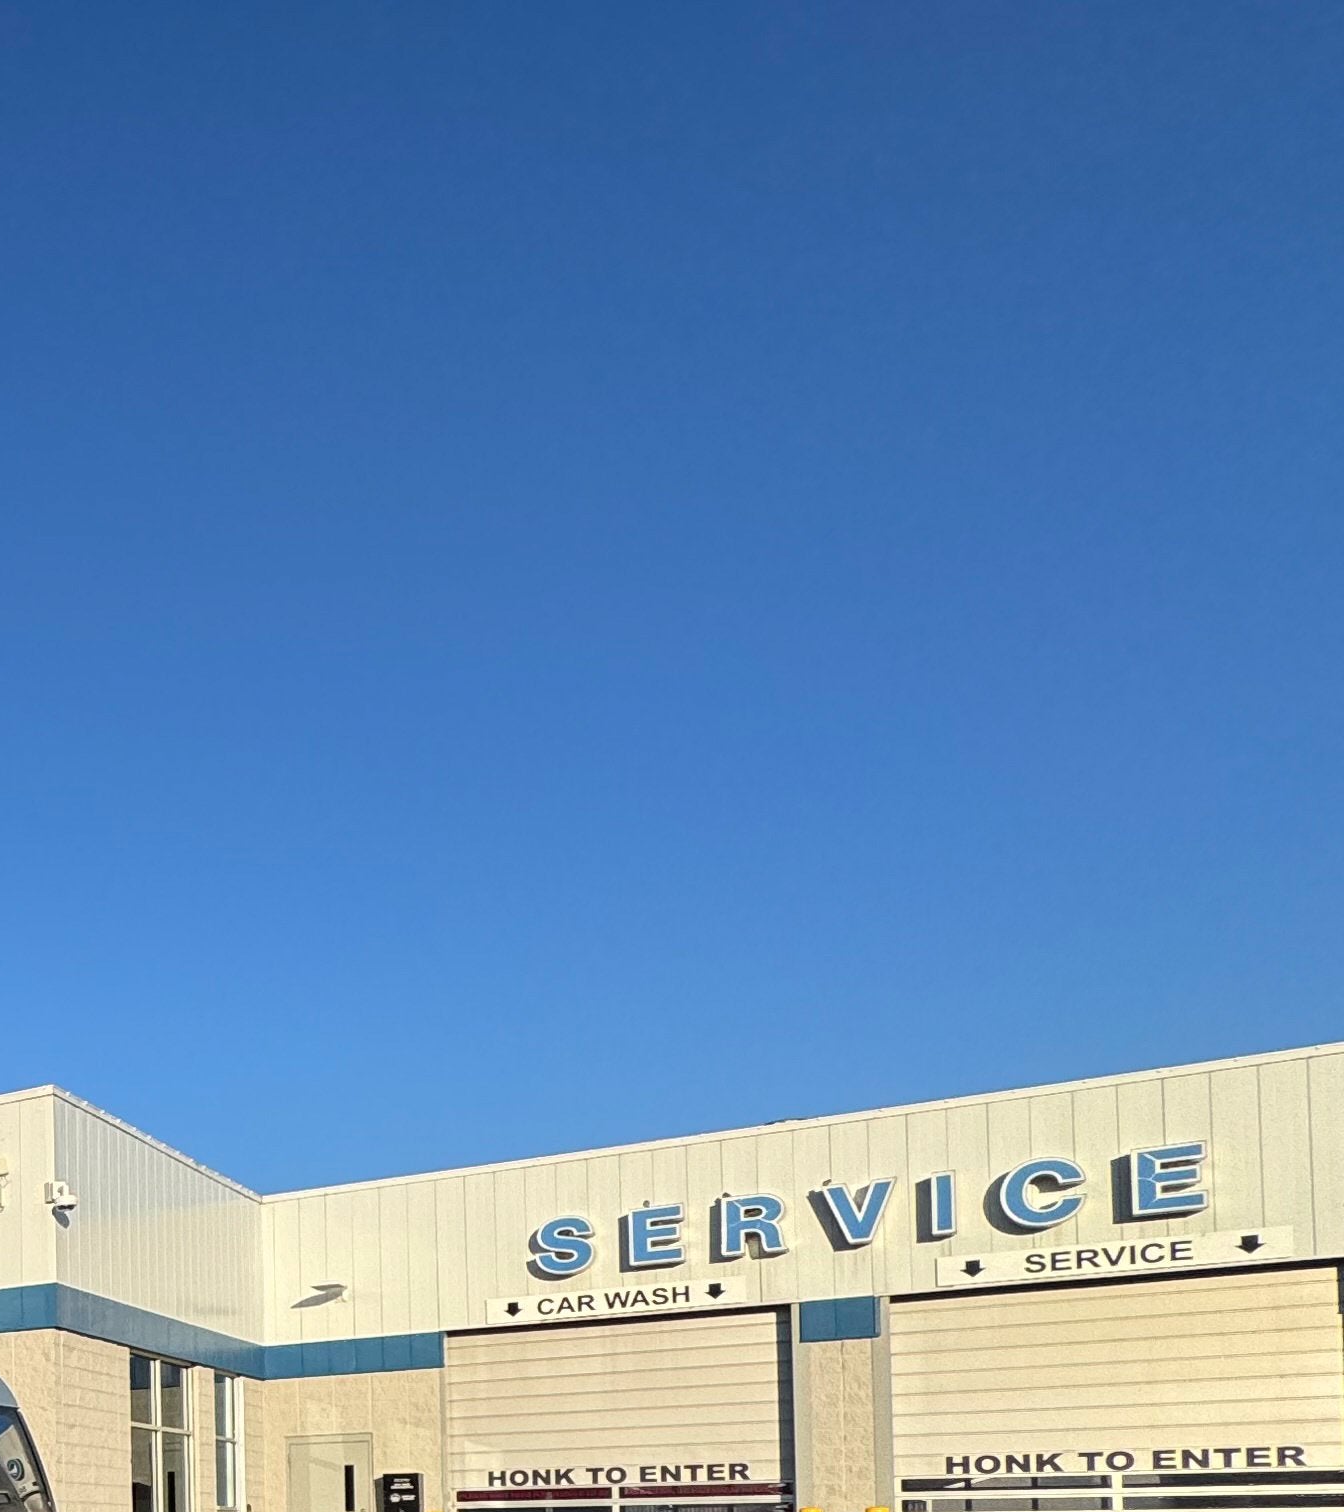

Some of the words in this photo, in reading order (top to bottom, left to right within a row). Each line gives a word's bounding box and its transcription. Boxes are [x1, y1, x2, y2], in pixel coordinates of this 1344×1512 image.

[532, 1140, 1209, 1275] SERVICE
[1024, 1240, 1194, 1274] SERVICE
[537, 1297, 596, 1316] CAR
[604, 1285, 691, 1309] WASH
[488, 1467, 576, 1487] HONK
[586, 1466, 627, 1485] TO
[639, 1463, 750, 1483] ENTER
[945, 1453, 1063, 1475] HONK
[1078, 1451, 1134, 1471] TO
[1152, 1446, 1307, 1470] ENTER
